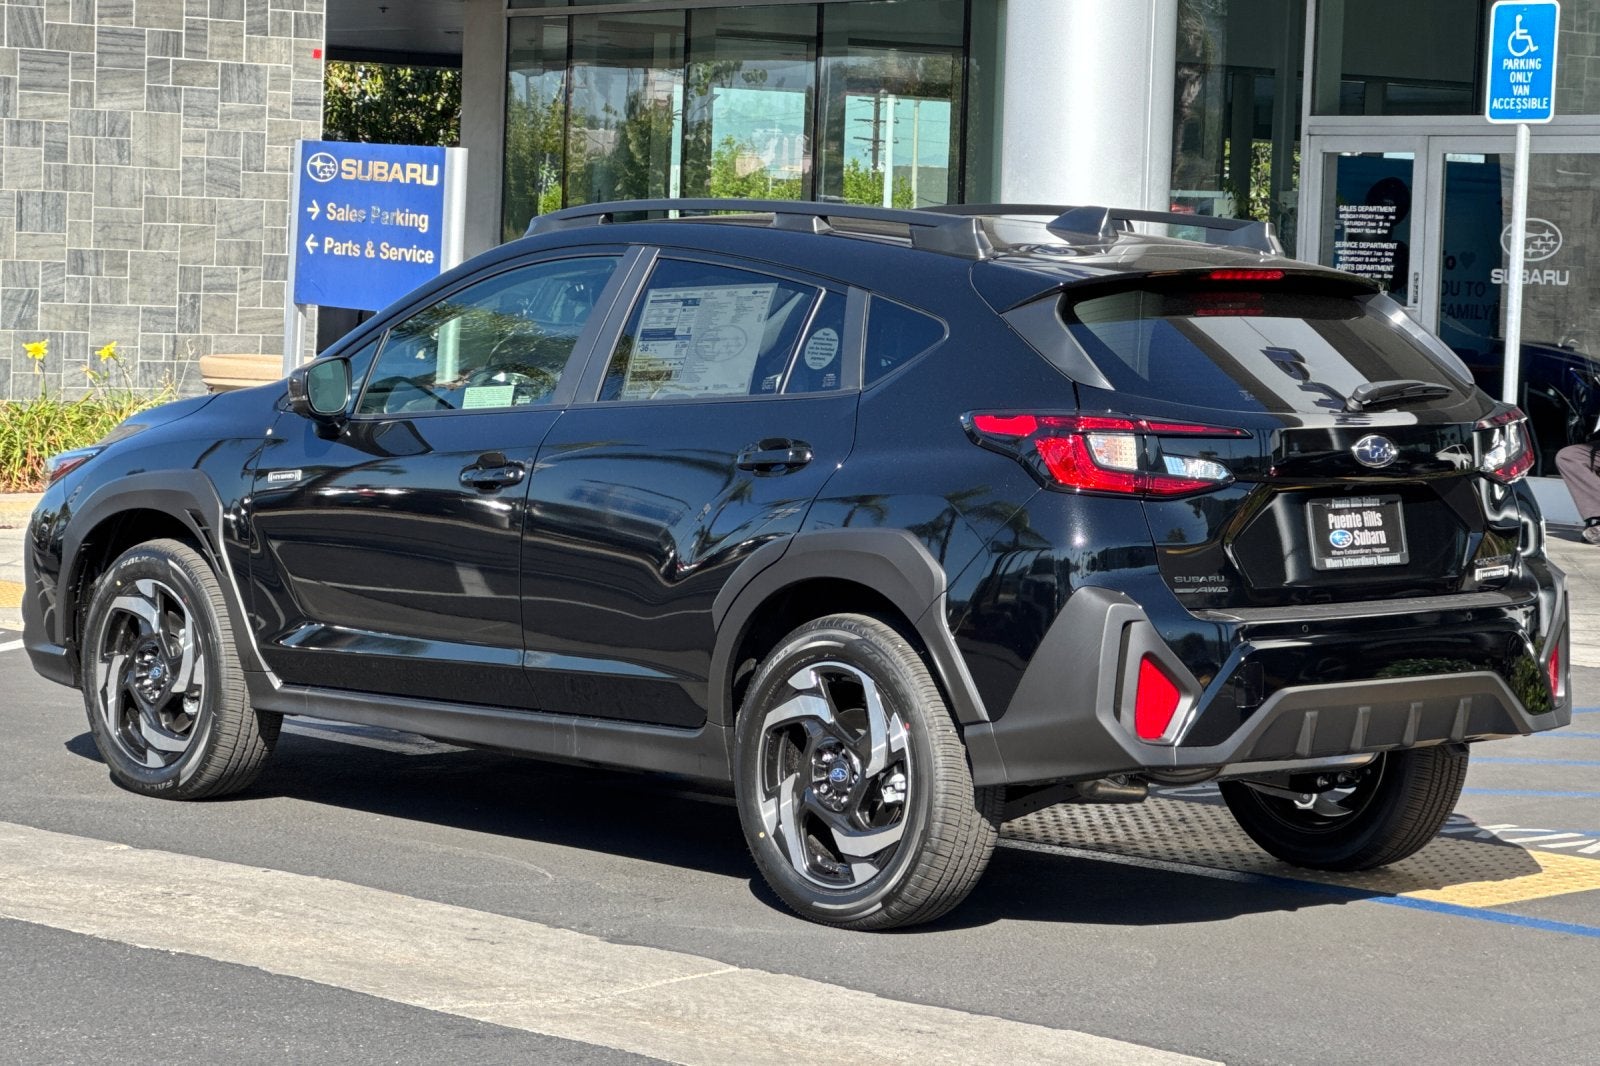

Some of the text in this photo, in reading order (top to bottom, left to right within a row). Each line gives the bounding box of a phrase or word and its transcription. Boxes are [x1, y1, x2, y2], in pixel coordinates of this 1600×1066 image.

[1502, 58, 1542, 70] PARKING
[1509, 71, 1533, 83] ONLY
[1512, 85, 1530, 96] VAN
[1492, 97, 1549, 110] ACCESSIBLE
[341, 158, 439, 186] SUBARU
[326, 202, 429, 233] Sales Parking
[323, 237, 435, 264] Parts & Service
[1466, 281, 1486, 298] TO
[1328, 510, 1383, 530] Puente Hills
[1353, 529, 1387, 546] Subaru
